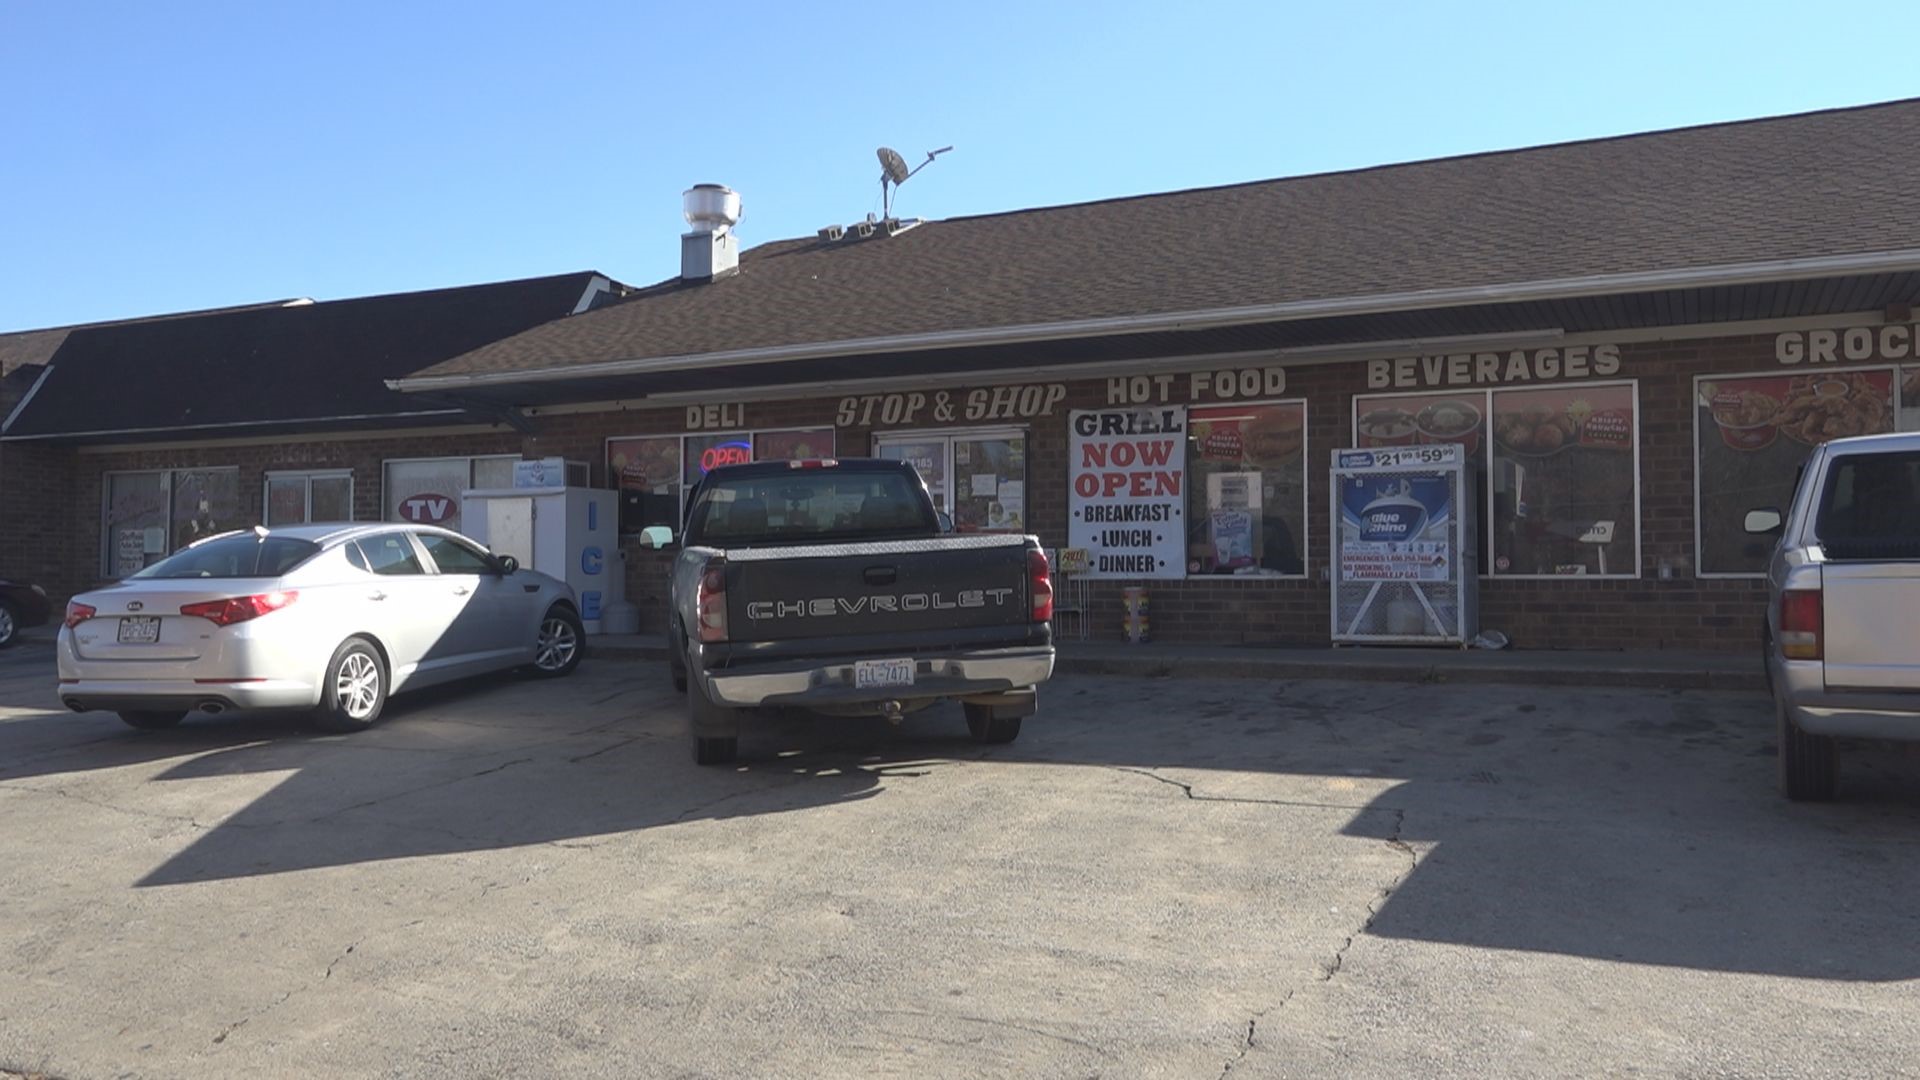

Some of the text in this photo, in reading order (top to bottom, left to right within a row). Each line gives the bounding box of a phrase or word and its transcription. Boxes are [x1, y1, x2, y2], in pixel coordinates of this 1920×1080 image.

[1776, 325, 1919, 364] GROC
[1367, 344, 1620, 389] BEVERAGES
[1107, 367, 1286, 405] HOT FOOD
[686, 403, 744, 429] DELI
[836, 384, 1067, 427] STOP & SHOP
[701, 447, 751, 472] OPEN
[1081, 440, 1175, 468] NOW
[1074, 469, 1182, 498] OPEN
[407, 500, 449, 520] TV
[1084, 504, 1172, 523] BREAKFAST
[1101, 530, 1152, 548] LUNCH
[581, 502, 603, 620] ICE
[1098, 555, 1155, 573] DINNER
[747, 588, 1013, 620] CHEVROLET
[858, 665, 911, 683] ELL-7471
